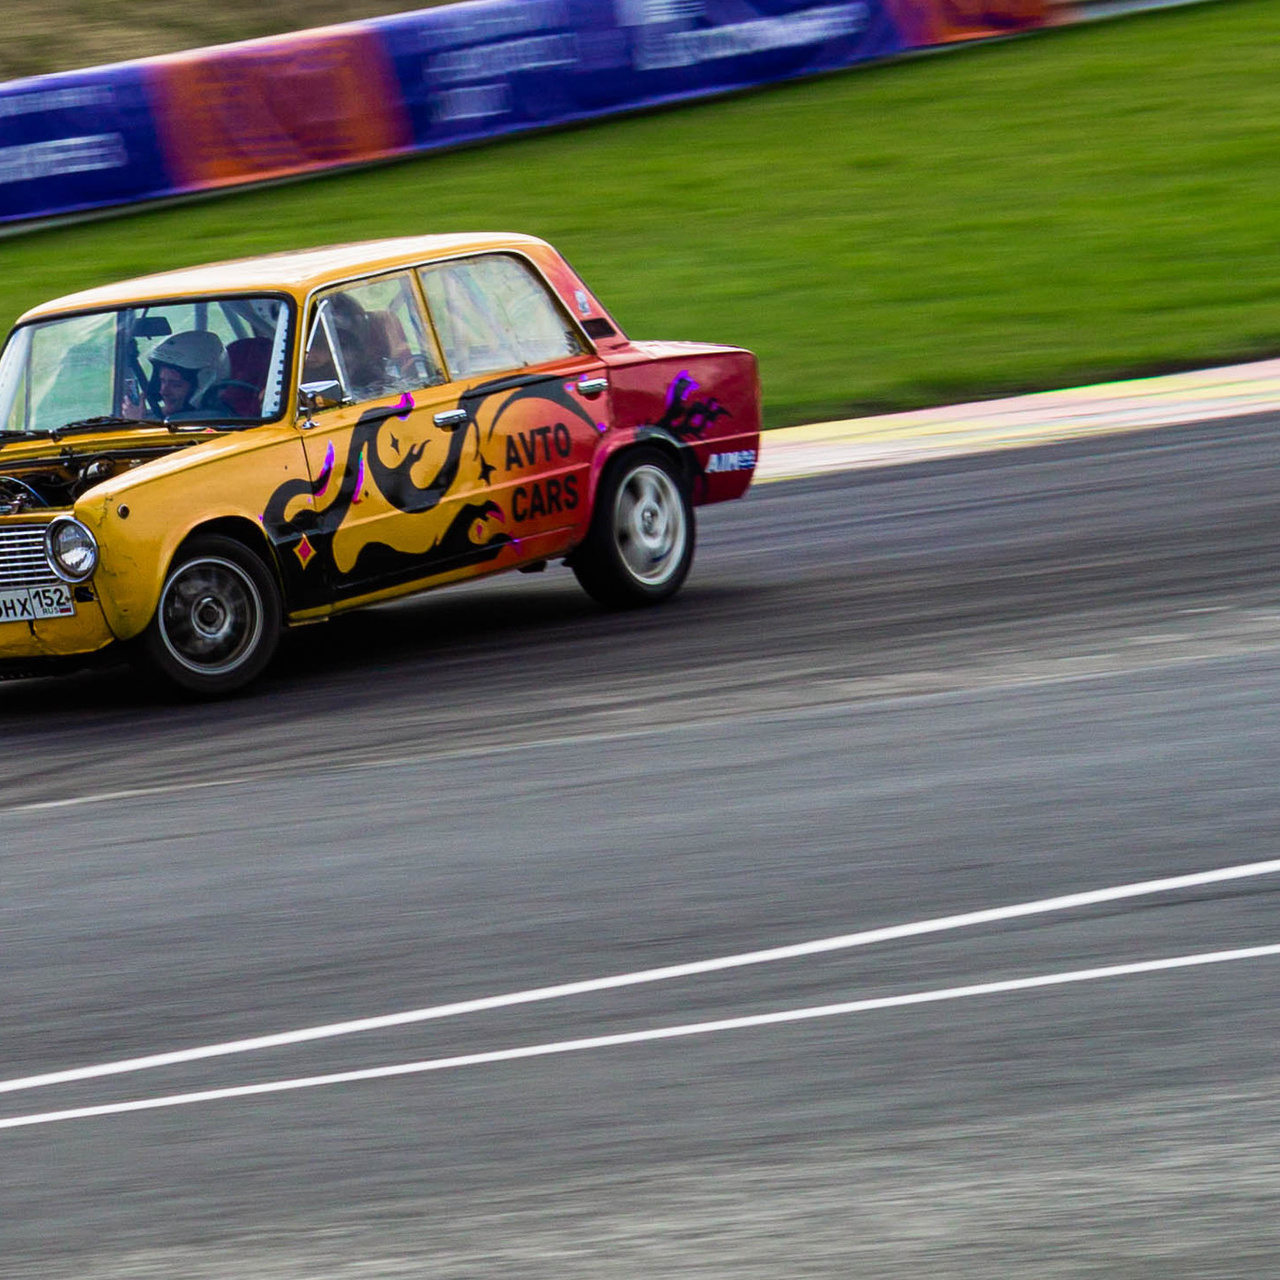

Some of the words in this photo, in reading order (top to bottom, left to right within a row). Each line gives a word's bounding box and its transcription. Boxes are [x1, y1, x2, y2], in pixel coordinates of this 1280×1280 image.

[505, 422, 571, 471] AVTO
[511, 474, 579, 522] CARS
[33, 588, 66, 608] 152
